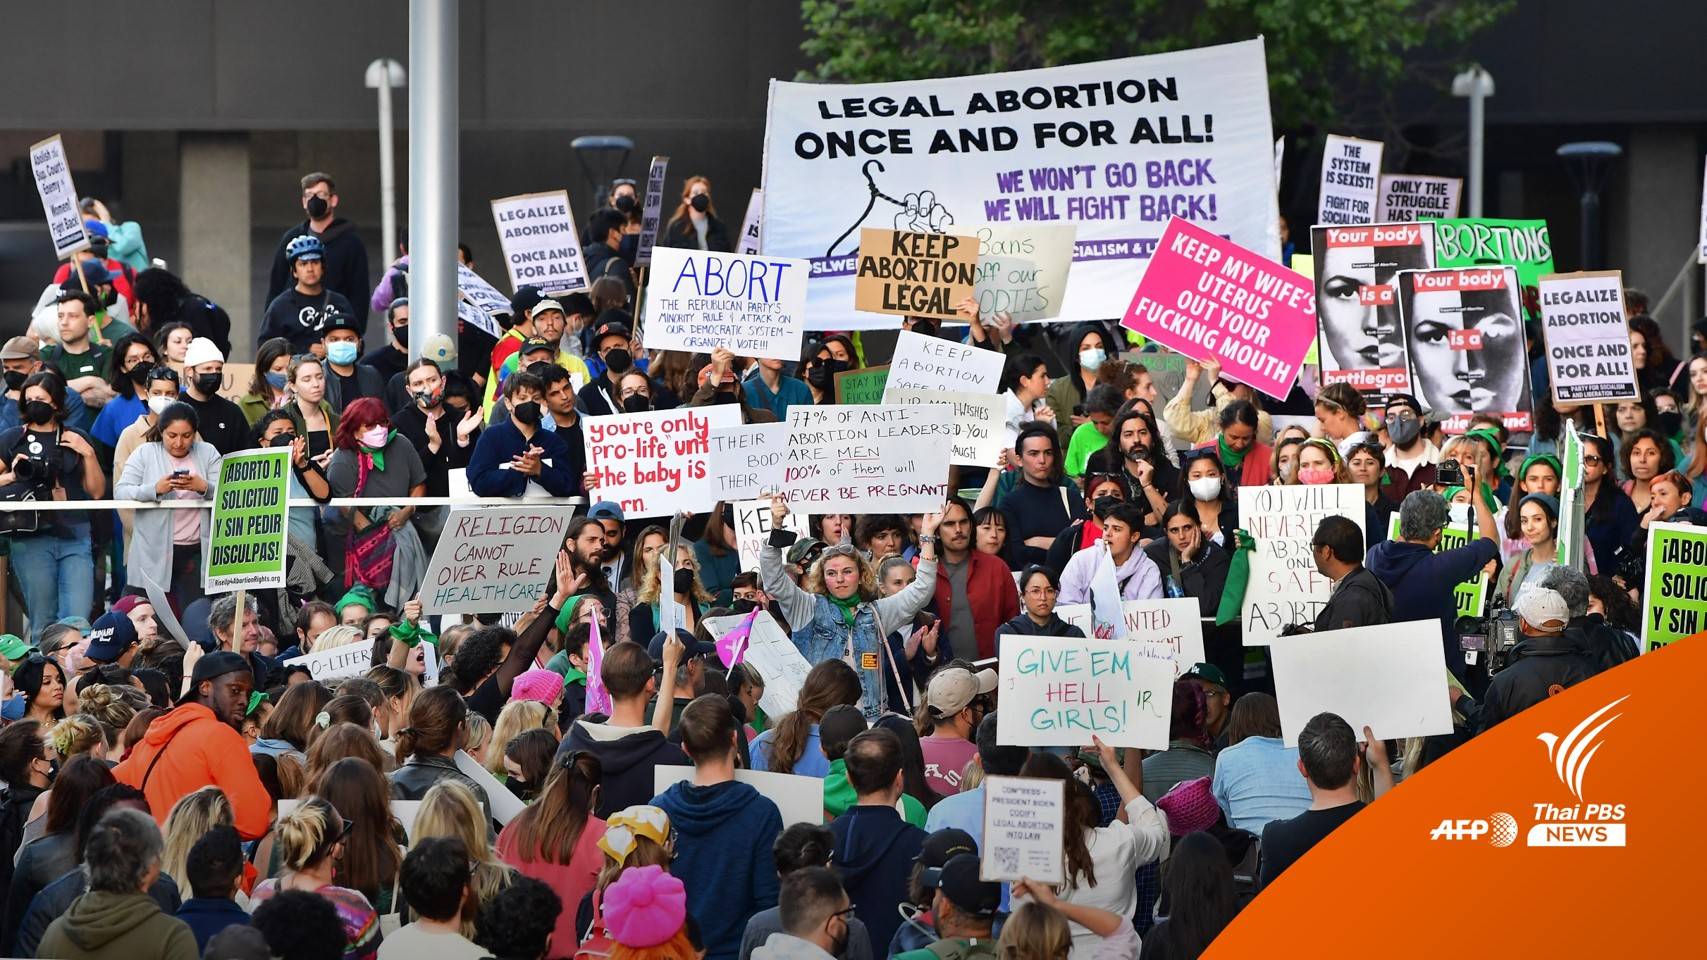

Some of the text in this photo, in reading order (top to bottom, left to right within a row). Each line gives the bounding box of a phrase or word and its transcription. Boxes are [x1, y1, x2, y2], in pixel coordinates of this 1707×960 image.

[818, 77, 1178, 119] LEGAL ABORTION
[795, 114, 1214, 159] ONCE AND FOR ALL!
[1344, 144, 1361, 158] THE
[997, 158, 1216, 193] WE WON'T GO BACK
[1331, 158, 1370, 174] SYSTEM
[1326, 171, 1374, 189] IS SEXIST!
[1392, 181, 1448, 195] ONLY THE
[984, 194, 1218, 221] WE WILL FIGHT BACK!
[1326, 195, 1369, 214] FIGHT FOR
[1386, 195, 1449, 209] STRUGGLE
[499, 205, 566, 221] LEGALIZE
[1388, 210, 1412, 222] HAS
[505, 222, 569, 238] ABORTION
[1328, 227, 1419, 244] Your body
[892, 231, 959, 259] KEEP
[511, 248, 577, 264] ONCE AND
[516, 262, 579, 279] FOR ALL!
[673, 257, 791, 302] ABORT
[858, 256, 976, 286] ABORTION
[1007, 267, 1042, 284] our
[1171, 232, 1222, 267] KEEP
[1221, 256, 1256, 283] MY
[1254, 270, 1316, 315] WIFE'S
[1415, 271, 1503, 288] Your body
[882, 283, 957, 315] LEGAL
[979, 285, 1049, 315] ODIES
[1198, 272, 1272, 320] UTERUS
[1361, 287, 1392, 301] is a
[1544, 289, 1618, 305] LEGALIZE
[661, 299, 781, 314] THE REPUBLICAN PARTY'S
[659, 313, 694, 323] MINORITY
[703, 313, 723, 321] RULE
[740, 314, 772, 323] ATTACK
[778, 315, 791, 323] ON
[1177, 290, 1271, 348] OUT YOUR
[1548, 312, 1621, 327] ABORTION
[666, 325, 742, 335] OUR DEMOCRATIC
[1451, 332, 1480, 345] is a
[684, 338, 768, 350] ORGANIZE VOTE!!!
[1135, 297, 1292, 384] FUCKING MOUTH
[922, 341, 973, 362] KEEP
[1552, 344, 1628, 359] ONCE AND
[899, 358, 985, 384] ABORTION
[1556, 362, 1628, 378] FOR ALL!
[846, 376, 868, 389] STAY
[661, 411, 709, 438] only
[792, 409, 919, 427] 77% OF ANTI-
[712, 433, 765, 451] THEIR
[788, 423, 950, 446] ABORTION LEADERS
[748, 452, 783, 468] BOD
[788, 446, 880, 461] ARE MEN
[224, 459, 280, 484] ¡ABORTO A
[593, 460, 706, 492] the baby is
[785, 460, 915, 482] 100% of them will
[717, 474, 760, 491] THEIR
[222, 487, 278, 510] SOLICITUD
[782, 488, 830, 503] NEVER
[837, 486, 860, 500] BE
[868, 484, 948, 498] PREGNANT
[1254, 486, 1351, 512] YOU WILL
[216, 514, 281, 538] Y SIN PEDIR
[455, 516, 564, 537] RELIGION
[1249, 514, 1306, 538] NEVER
[212, 542, 279, 566] DISCULPAS!
[455, 543, 514, 562] CANNOT
[1662, 538, 1707, 565] ¡ABO
[438, 558, 542, 586] OVER RULE
[1287, 558, 1315, 570] ONL
[1653, 606, 1663, 631] Y
[1668, 608, 1698, 634] SIN
[1017, 648, 1082, 678] GIVE
[1085, 647, 1132, 681] 'EM
[1046, 682, 1110, 703] HELL
[1030, 700, 1128, 733] GIRLS!
[992, 797, 1055, 807] PRESIDENT BIDEN
[1009, 809, 1035, 817] CODIFY
[993, 819, 1054, 830] LEGAL ABORTION
[1024, 832, 1040, 840] LAW
